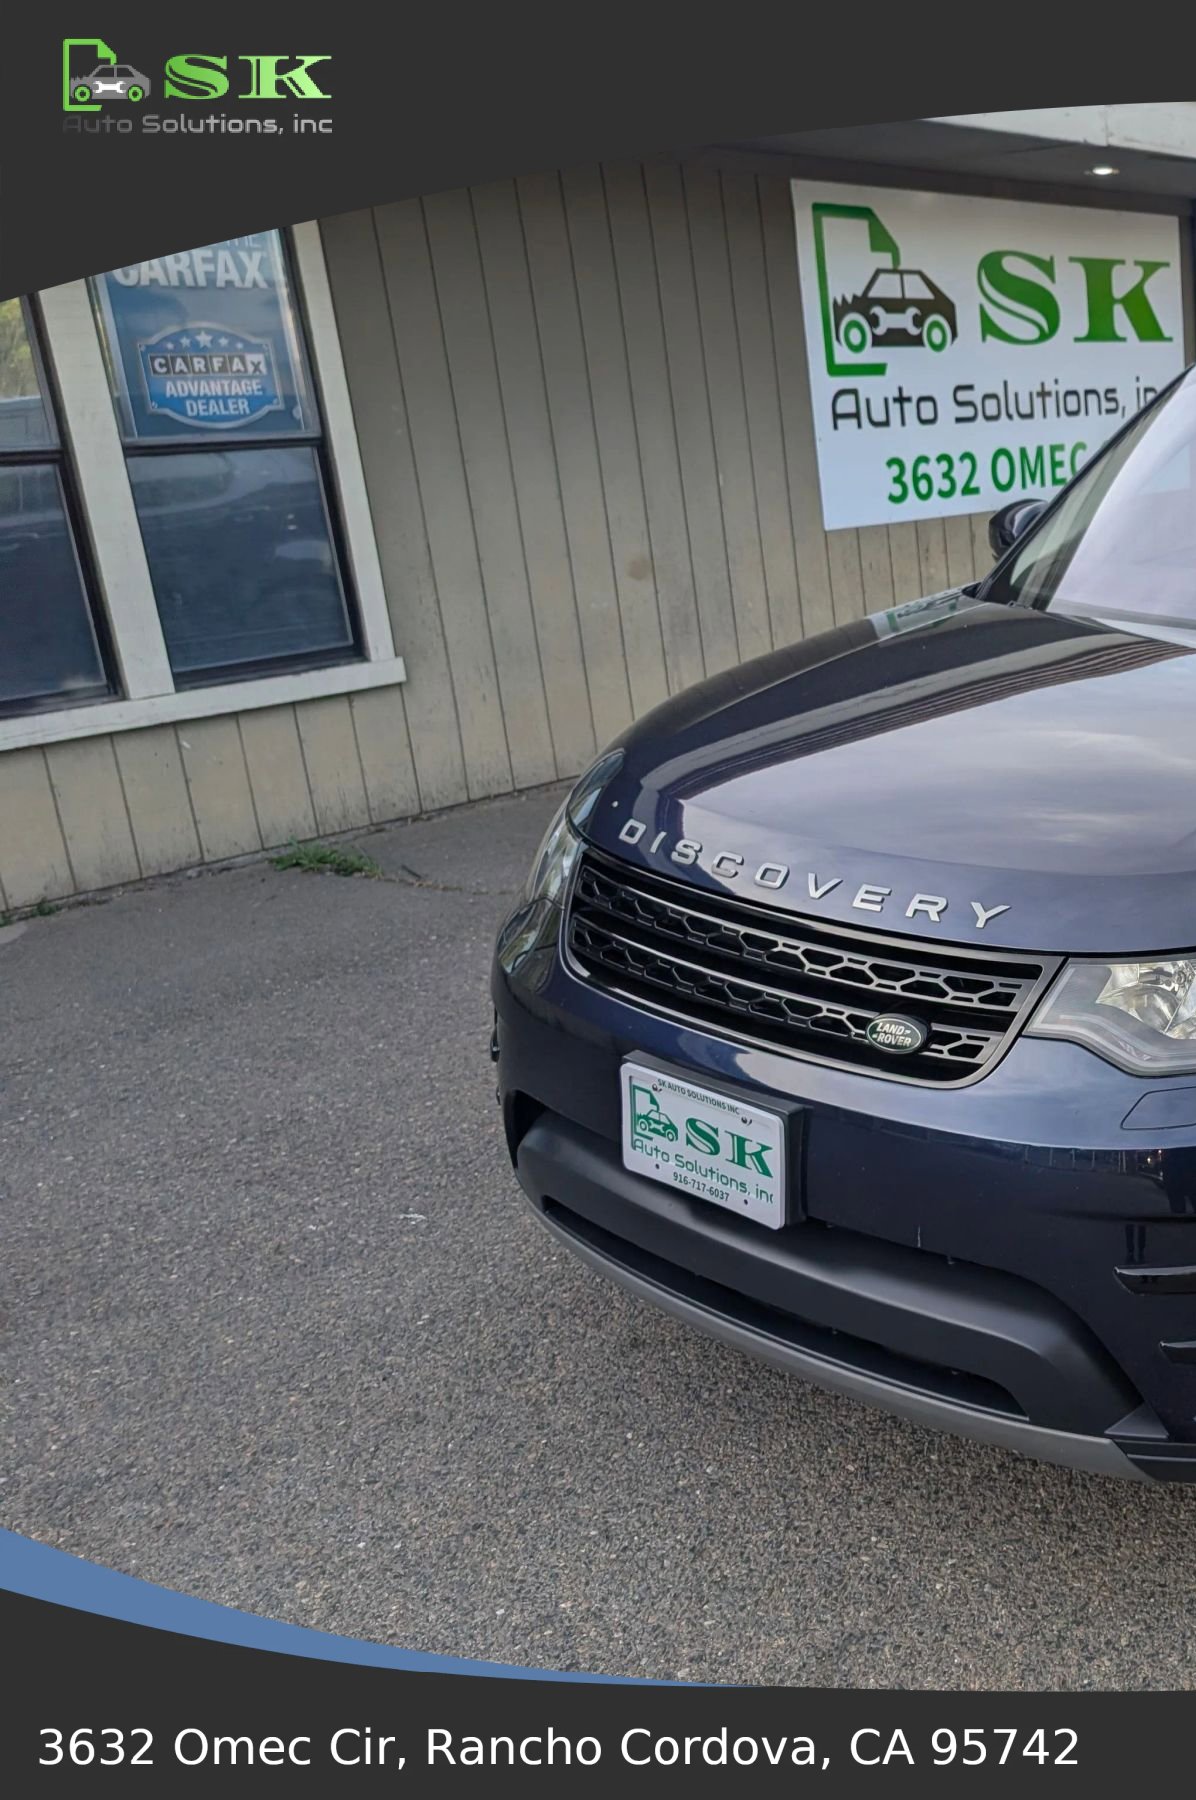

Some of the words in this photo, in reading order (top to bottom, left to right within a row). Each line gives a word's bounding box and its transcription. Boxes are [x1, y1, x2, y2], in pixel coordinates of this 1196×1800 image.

[976, 249, 1174, 345] SK
[153, 356, 264, 375] CARFAX
[165, 378, 263, 398] ADVANTAGE
[186, 398, 250, 417] DEALER
[831, 385, 939, 431] Auto
[953, 378, 1126, 424] Solutions,
[886, 451, 980, 505] 3632
[618, 818, 1012, 929] DISCOVERY
[657, 1078, 667, 1088] SK
[667, 1081, 687, 1095] AUTO
[687, 1089, 727, 1110] SOLUTIONS
[727, 1102, 740, 1115] INC
[633, 1138, 670, 1163] Auto
[675, 1153, 751, 1196] Solutions,
[685, 1117, 774, 1178] SK
[673, 1171, 730, 1202] 916-717-6037
